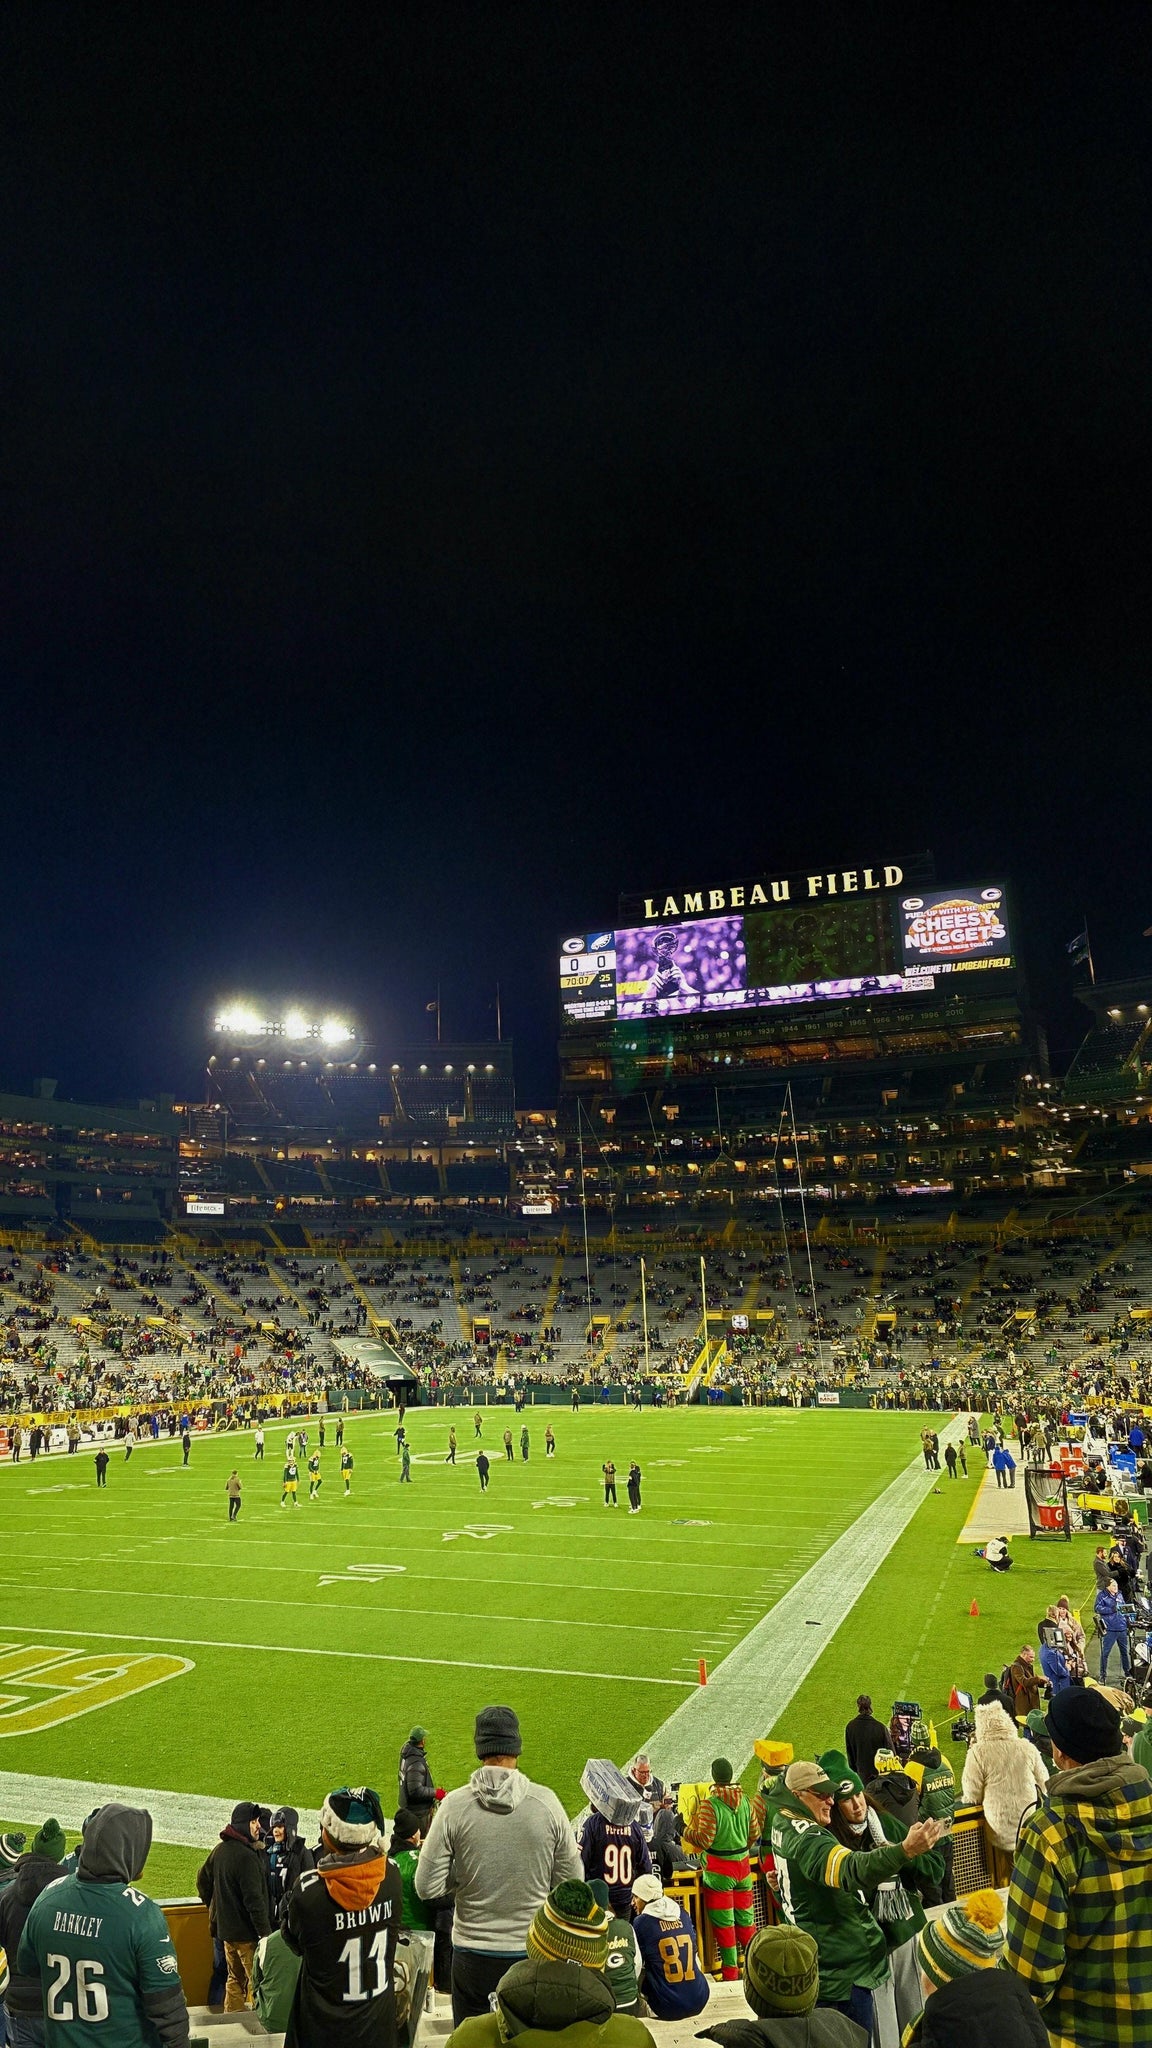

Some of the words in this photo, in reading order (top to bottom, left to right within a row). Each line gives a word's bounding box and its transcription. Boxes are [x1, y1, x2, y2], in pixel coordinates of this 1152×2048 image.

[644, 880, 791, 918] LAMBEAU
[807, 866, 903, 896] FIELD
[905, 911, 926, 919] FUEL
[927, 909, 938, 917] UP
[939, 907, 960, 915] WITH
[961, 905, 977, 913] THE
[978, 902, 1001, 911] NEW
[911, 910, 996, 932] CHEESY
[904, 924, 1006, 948] NUGGETS
[571, 959, 578, 971] 0
[597, 956, 605, 968] 0
[905, 964, 942, 976] WELCOME
[942, 964, 952, 973] TO
[952, 960, 988, 971] LAMBEAU
[988, 958, 1011, 968] FIELD
[566, 977, 589, 986] 70:07
[715, 1031, 730, 1039] 1931
[897, 1014, 914, 1022] 1967
[604, 1844, 632, 1885] 90
[53, 1911, 103, 1938] BARKLEY
[335, 1900, 393, 1931] BROWN
[338, 1928, 388, 2001] 11
[658, 1934, 696, 1983] 87
[47, 1952, 109, 2022] 26
